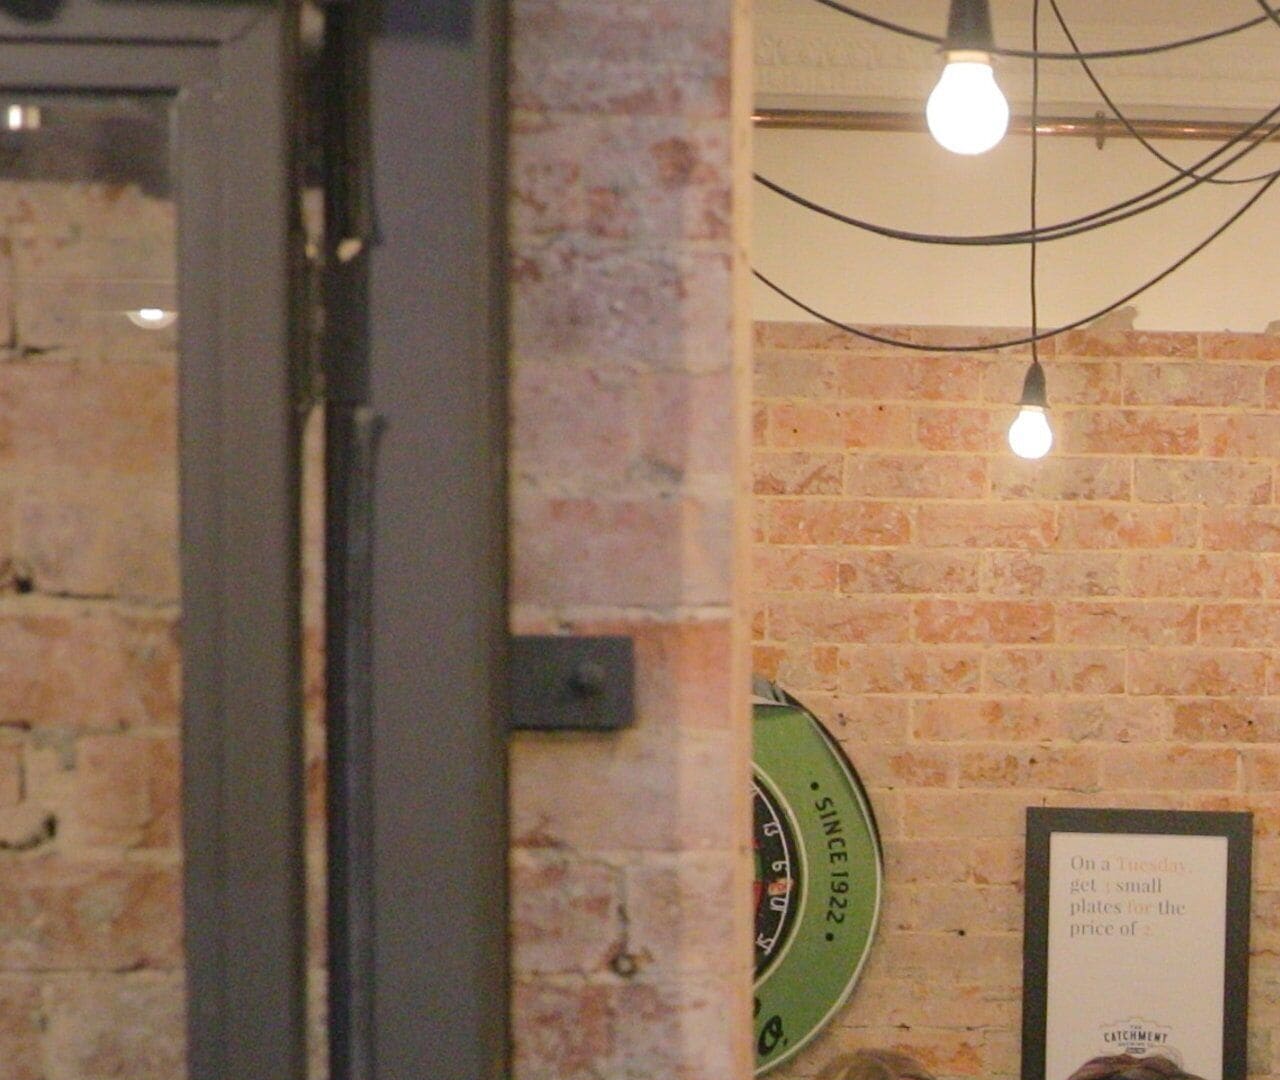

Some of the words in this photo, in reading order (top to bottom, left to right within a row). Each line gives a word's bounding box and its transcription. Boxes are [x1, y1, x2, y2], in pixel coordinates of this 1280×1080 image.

[815, 797, 849, 864] SINCE
[1070, 854, 1096, 872] On
[1101, 858, 1111, 872] a
[1070, 878, 1096, 895] get
[1116, 877, 1162, 894] small
[826, 871, 850, 924] 1922
[1070, 898, 1122, 916] plates
[1127, 899, 1153, 914] for
[1158, 899, 1186, 915] the
[1070, 920, 1115, 938] price
[1119, 920, 1139, 936] of
[1103, 1030, 1168, 1043] CATCHMENT
